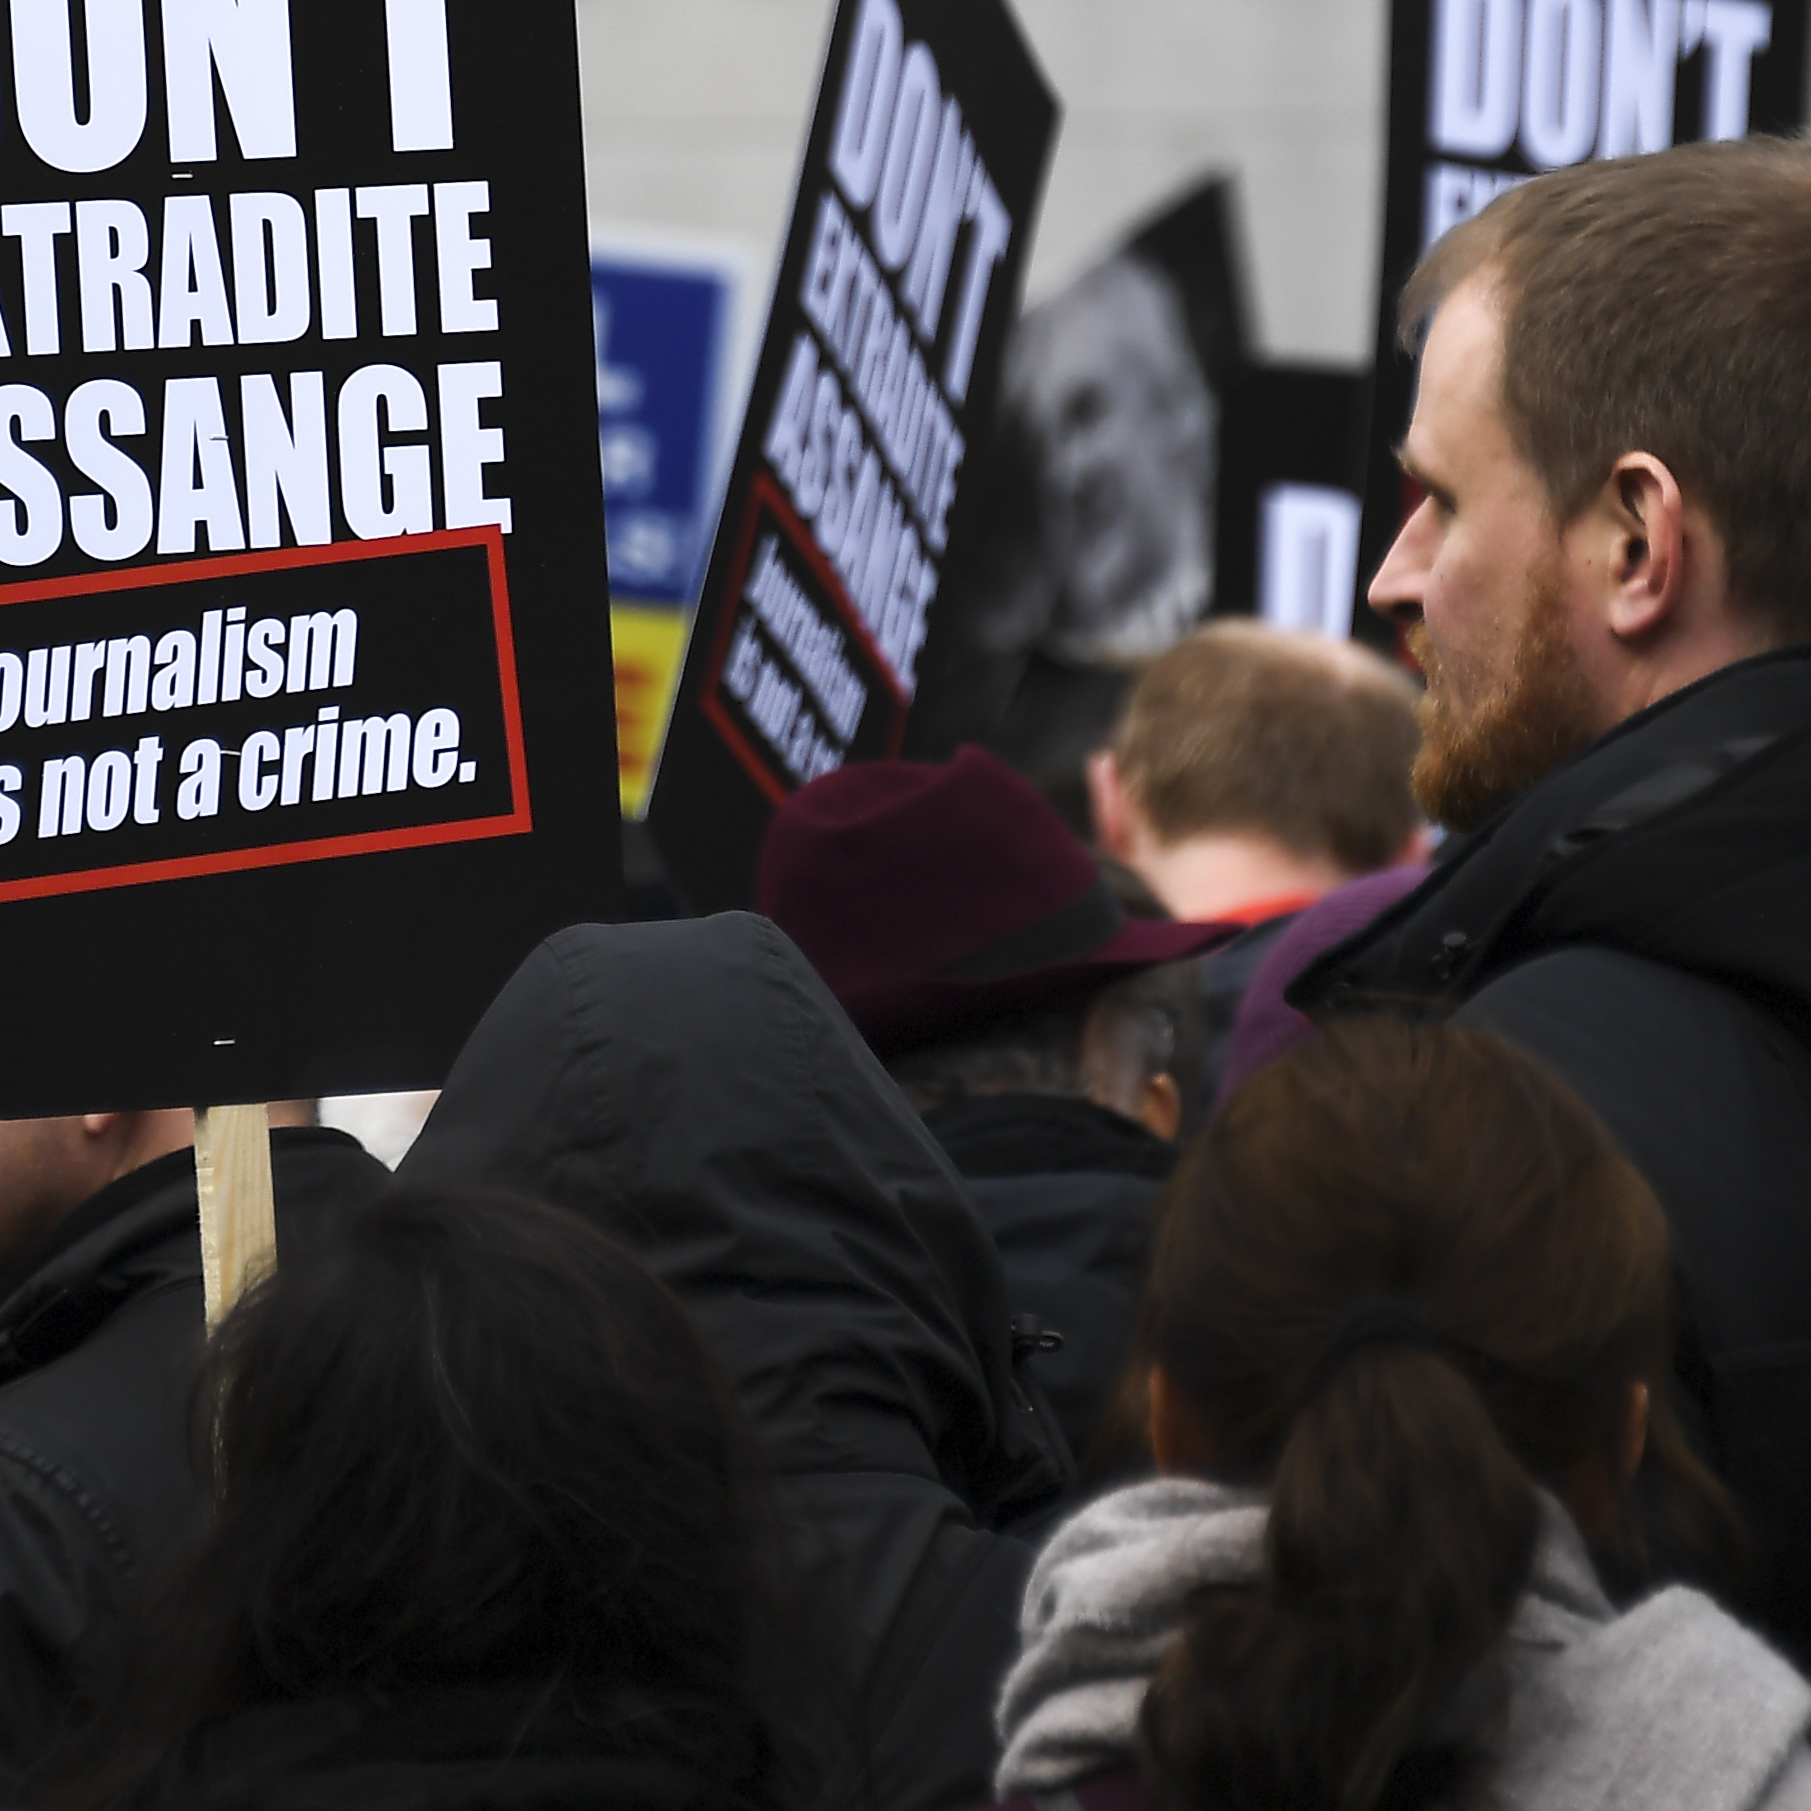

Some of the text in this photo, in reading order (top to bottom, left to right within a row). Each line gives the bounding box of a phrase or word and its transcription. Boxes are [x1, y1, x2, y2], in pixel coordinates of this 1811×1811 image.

[38, 736, 163, 838] not
[176, 743, 224, 820] a
[236, 706, 476, 814] crime.
